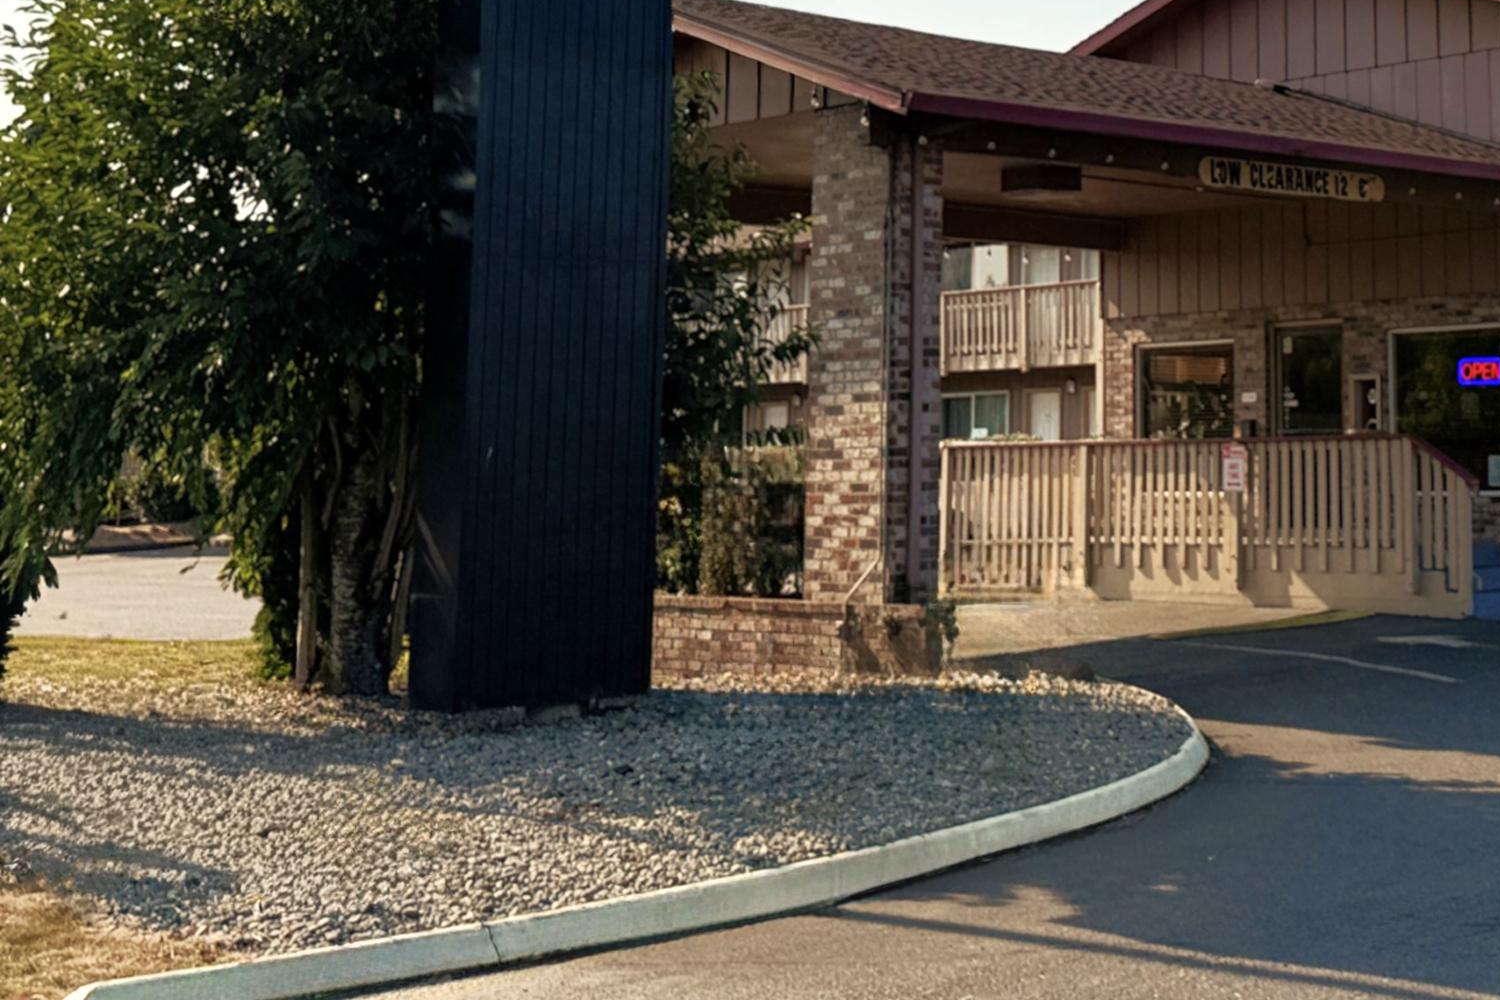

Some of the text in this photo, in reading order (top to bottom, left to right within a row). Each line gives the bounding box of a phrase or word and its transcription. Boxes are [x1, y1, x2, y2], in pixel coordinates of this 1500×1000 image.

[1210, 159, 1241, 186] LOW
[1250, 162, 1329, 194] CLEARANCE
[1463, 362, 1500, 381] OPEN
